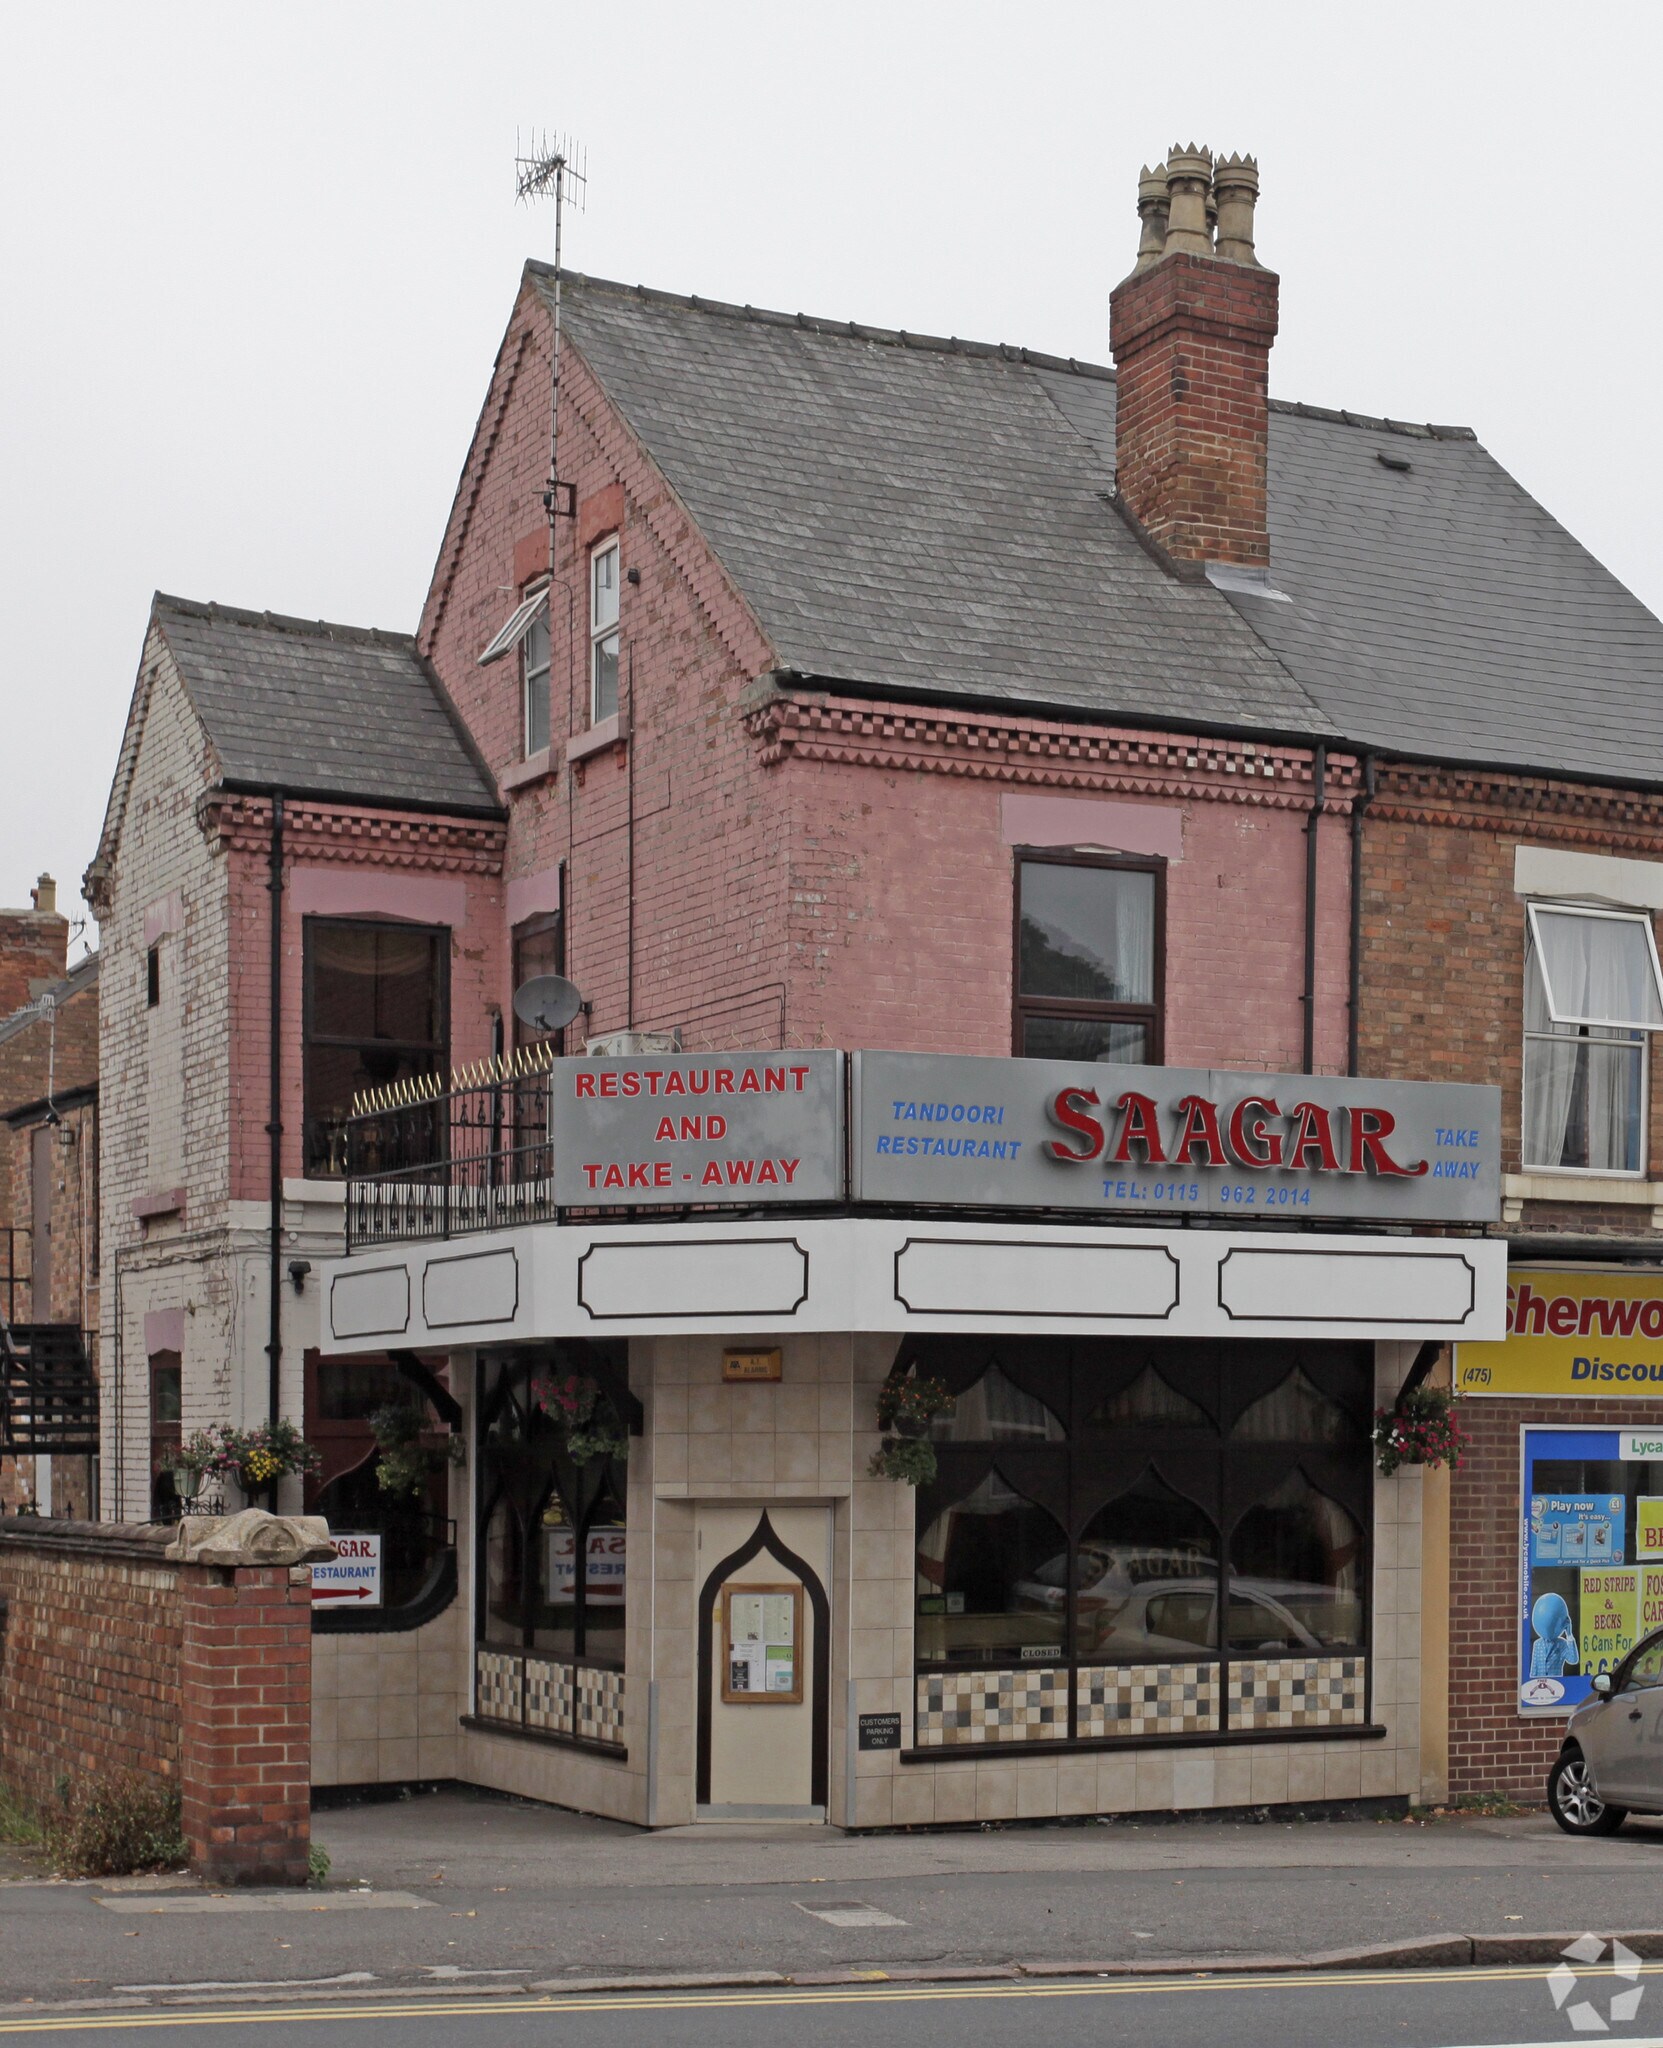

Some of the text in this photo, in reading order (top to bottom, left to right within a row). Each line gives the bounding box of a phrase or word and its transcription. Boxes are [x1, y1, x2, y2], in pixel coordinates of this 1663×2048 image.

[576, 1066, 810, 1098] RESTAURANT
[892, 1101, 1005, 1125] TANDOORI
[654, 1115, 727, 1142] AND
[1045, 1086, 1429, 1178] SAAGAR
[1434, 1128, 1479, 1147] TAKE
[876, 1135, 1022, 1160] RESTAURANT
[1432, 1161, 1481, 1180] AWAY
[1103, 1180, 1311, 1206] TEL: 0115 962 2014
[1463, 1368, 1492, 1386] (475)
[1571, 1357, 1663, 1381] Discou
[1632, 1438, 1663, 1456] Lyca
[1551, 1501, 1571, 1513] Play
[1574, 1502, 1594, 1511] now
[312, 1567, 377, 1579] ESTAURANT
[1584, 1576, 1636, 1593] RED STRIPE
[1646, 1575, 1663, 1596] FO
[1605, 1599, 1614, 1609] &
[1594, 1614, 1622, 1630] BECKS
[1583, 1635, 1589, 1652] 6
[1592, 1635, 1613, 1651] Cans
[1616, 1633, 1632, 1651] For
[1022, 1649, 1060, 1657] CLOSED
[860, 1718, 899, 1727] CUSTOMERS
[866, 1728, 894, 1736] PARKING
[871, 1737, 889, 1745] ONLY
